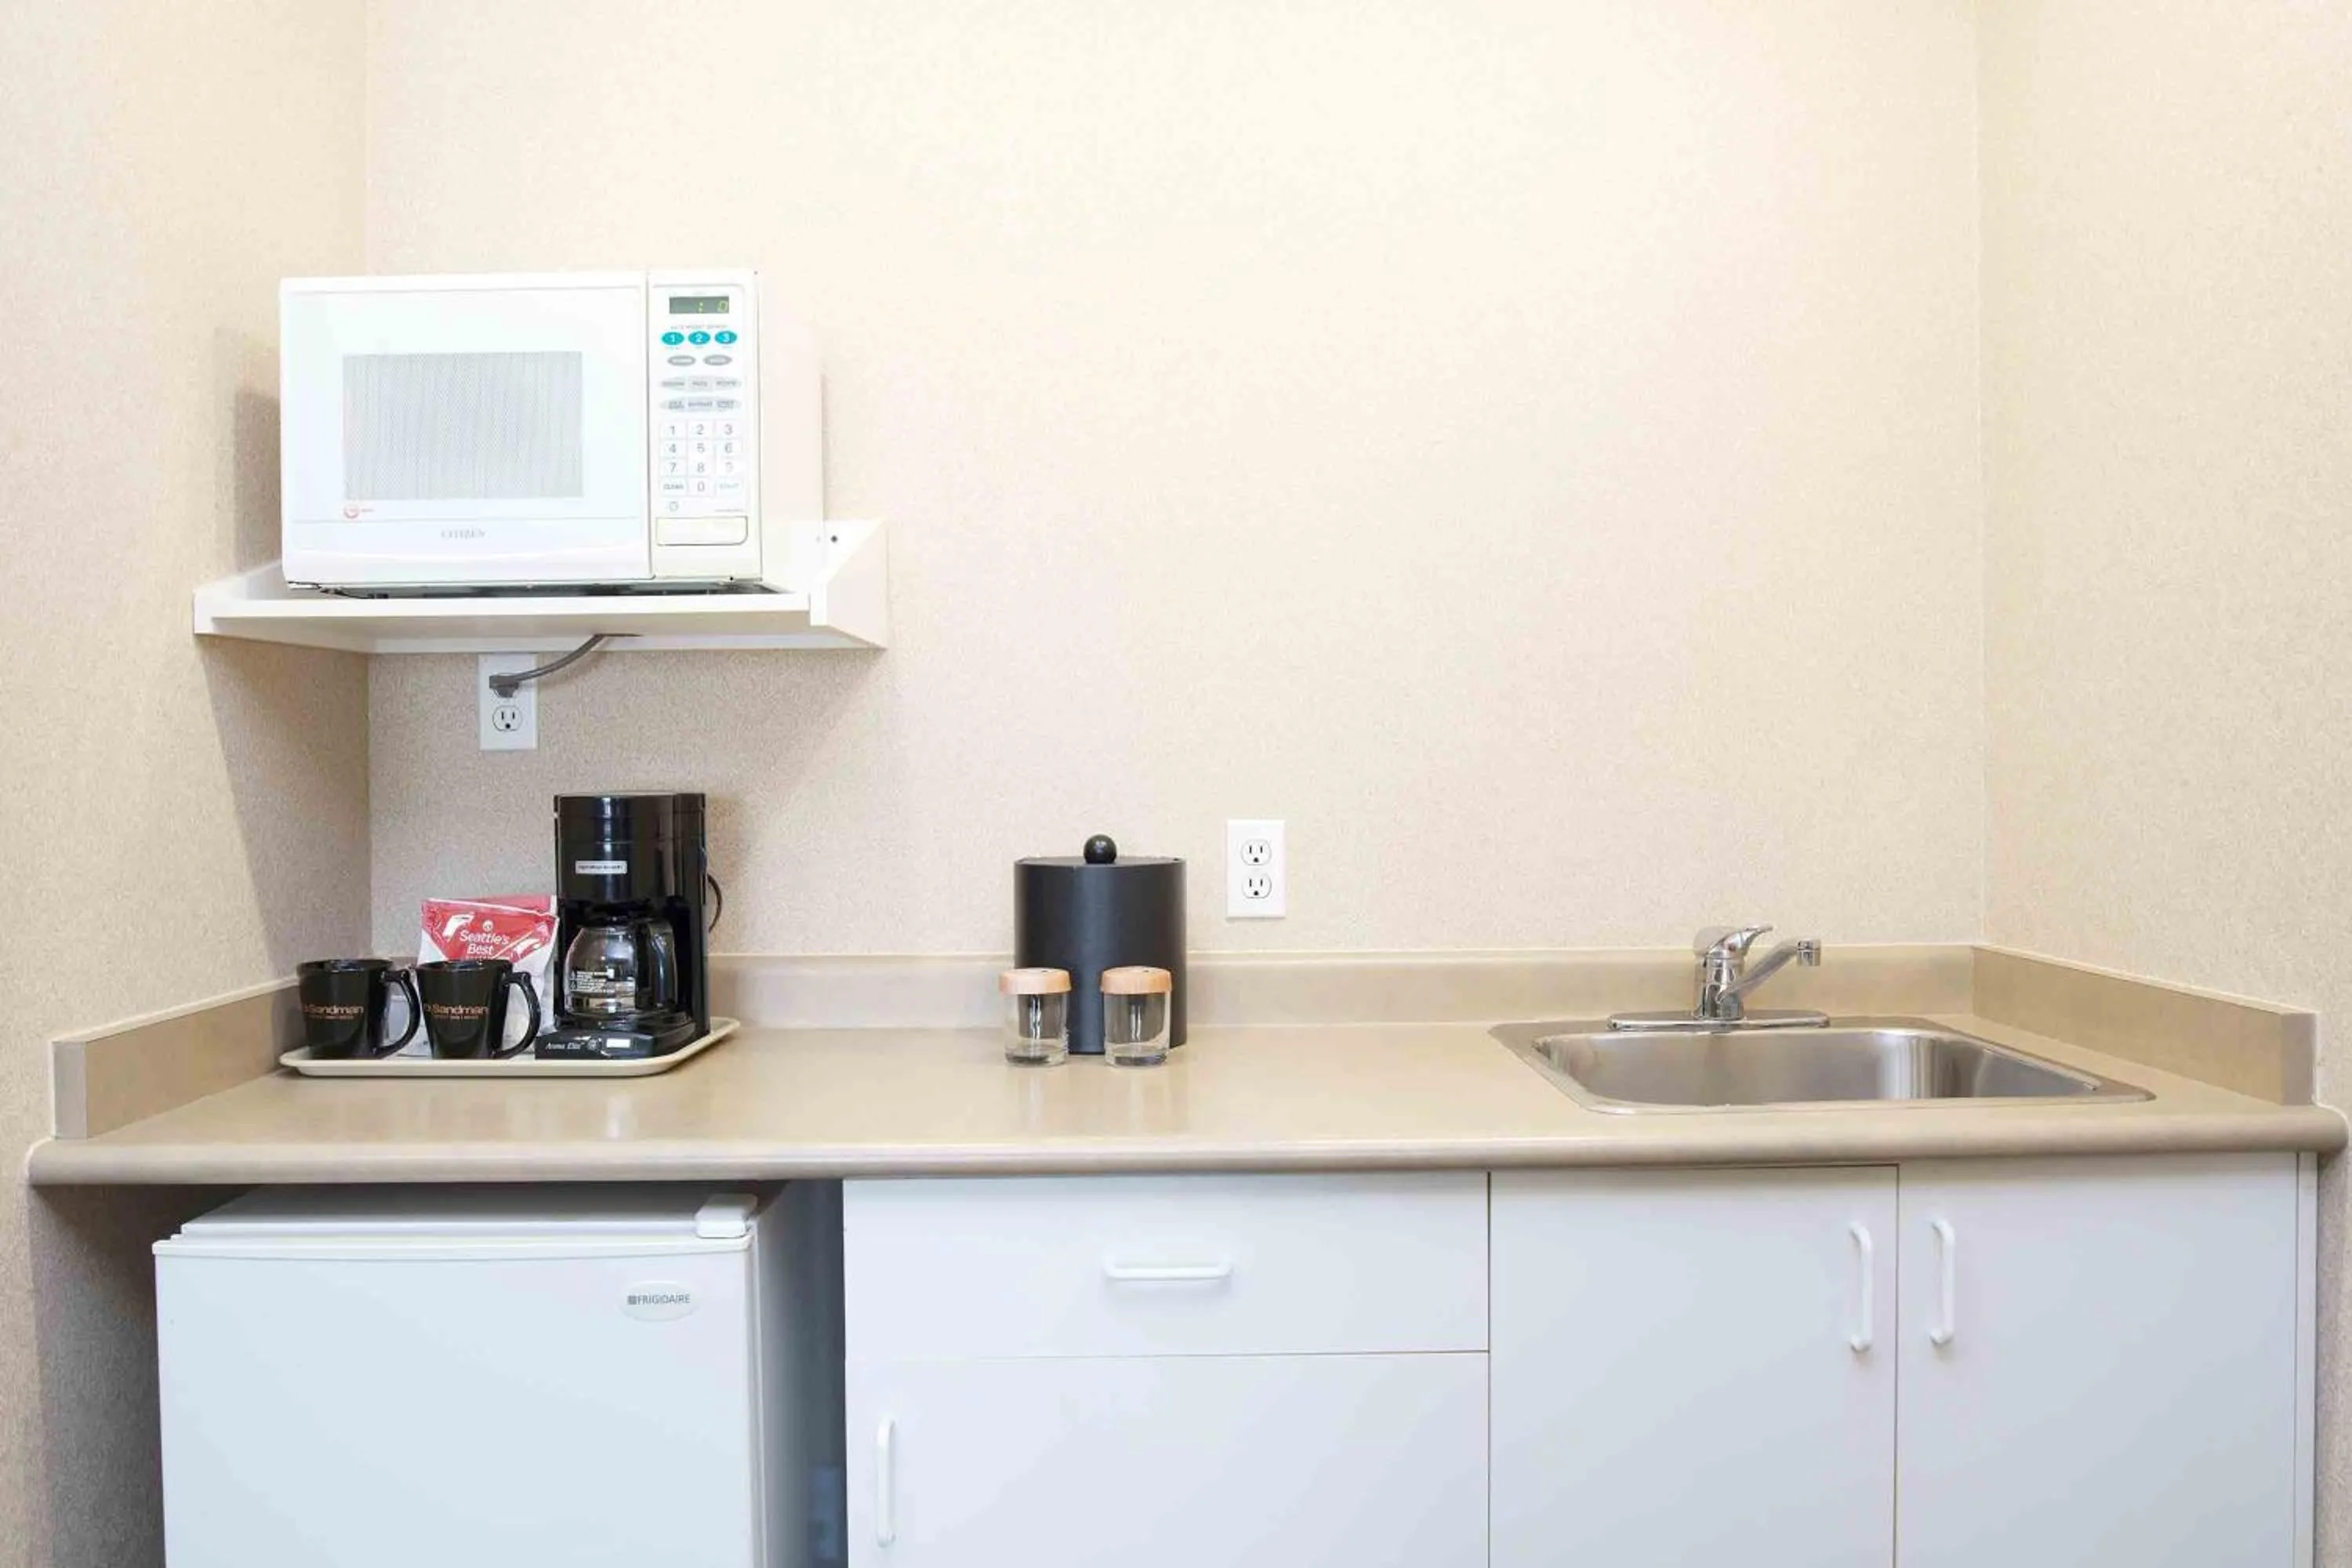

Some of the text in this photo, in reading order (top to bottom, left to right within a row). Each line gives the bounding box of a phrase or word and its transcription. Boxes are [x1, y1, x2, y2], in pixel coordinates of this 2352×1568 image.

[696, 424, 704, 435] 2
[724, 424, 733, 435] 3
[669, 442, 733, 453] 4 5 6
[670, 462, 734, 473] 7 8 9
[697, 481, 705, 492] 0
[459, 929, 510, 946] Seattle's
[467, 943, 494, 956] Best
[309, 1004, 364, 1014] Sandman
[433, 1004, 489, 1014] Sandman
[637, 1294, 691, 1305] FRIGIDAIRE
